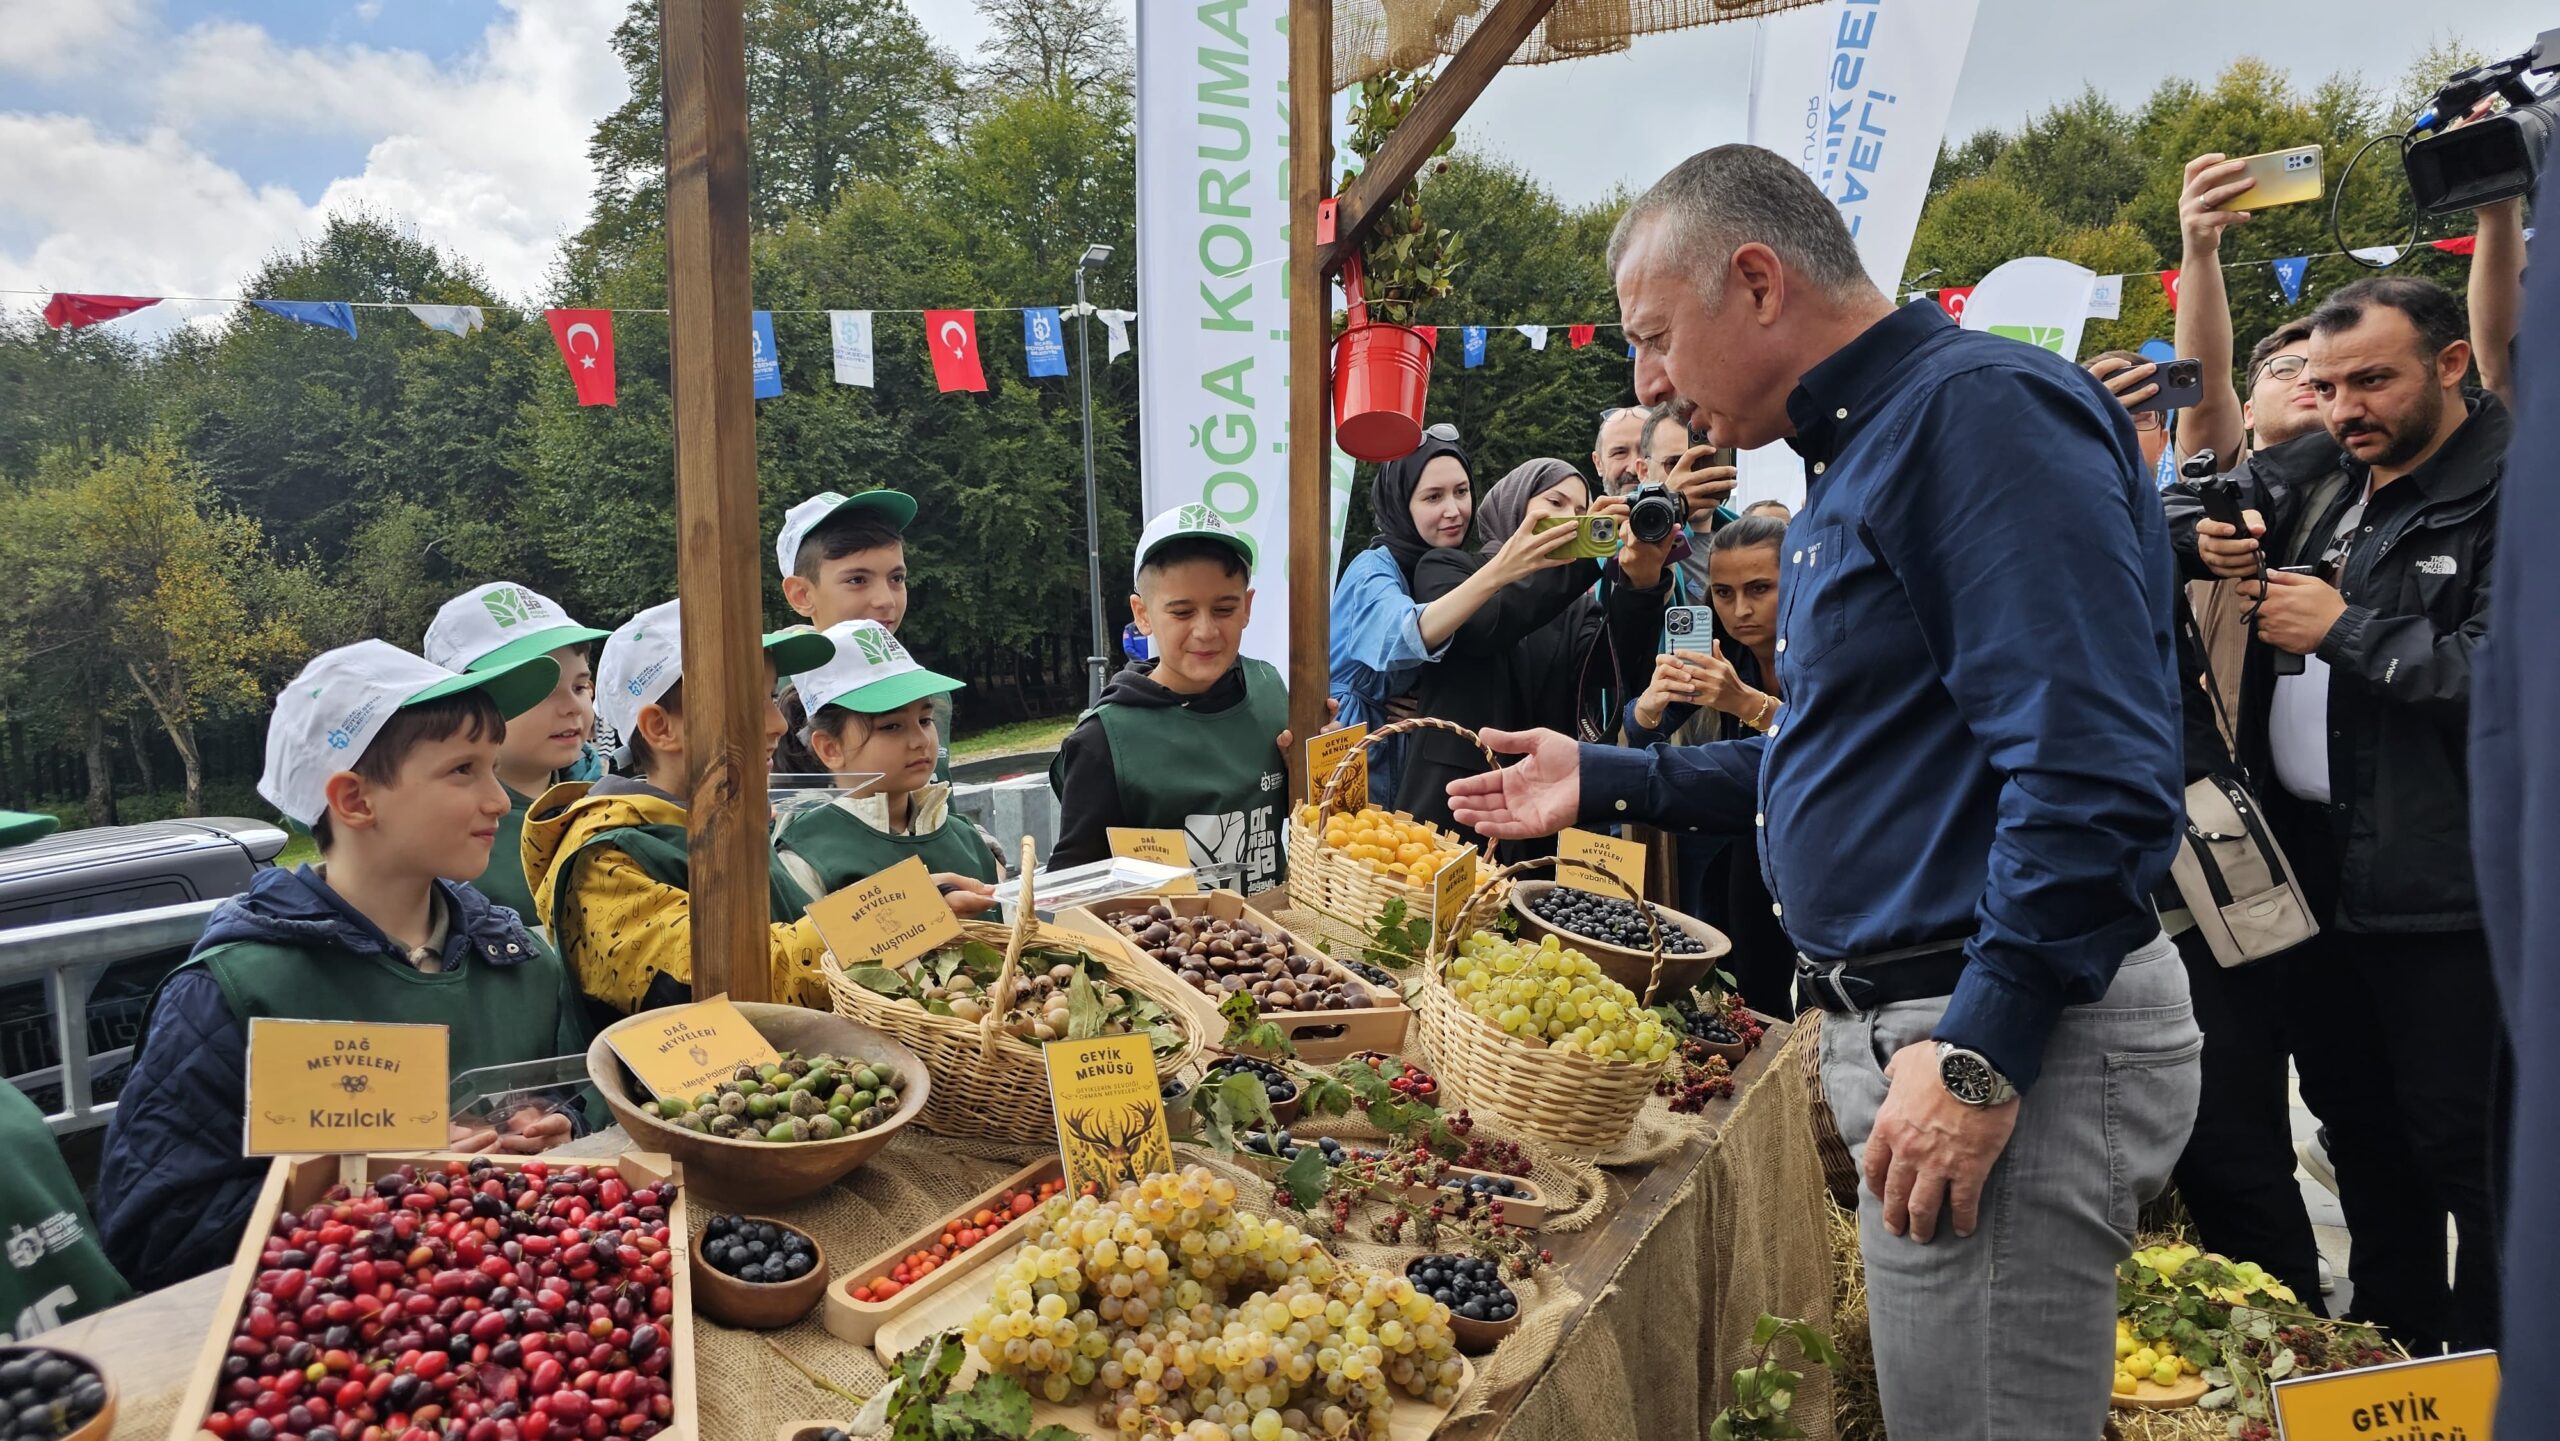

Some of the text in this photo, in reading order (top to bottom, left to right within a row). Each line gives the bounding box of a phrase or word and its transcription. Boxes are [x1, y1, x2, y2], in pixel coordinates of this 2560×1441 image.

[1198, 0, 1254, 332] KORUMA
[2415, 560, 2443, 569] NORTH
[1580, 718, 1599, 742] Canon
[1325, 736, 1349, 748] GEYİK
[1141, 835, 1155, 844] DAĞ
[1594, 841, 1611, 850] DAĞ
[1582, 848, 1624, 863] MEYVELERİ
[1580, 872, 1607, 884] Yabani
[859, 885, 882, 902] DAĞ
[851, 890, 906, 922] MEYVELERİ
[870, 922, 926, 957] Muşmula
[663, 1021, 688, 1036] DAĞ
[334, 1037, 370, 1051] DAĞ
[658, 1028, 717, 1054] MEYVELERİ
[1080, 1046, 1121, 1064] GEYİK
[306, 1054, 401, 1074] MEYVELERİ
[1076, 1061, 1134, 1081] MENÜSÜ
[682, 1076, 706, 1089] Meşe
[309, 1108, 396, 1128] Kızılcık
[2352, 1391, 2441, 1432] GEYİK
